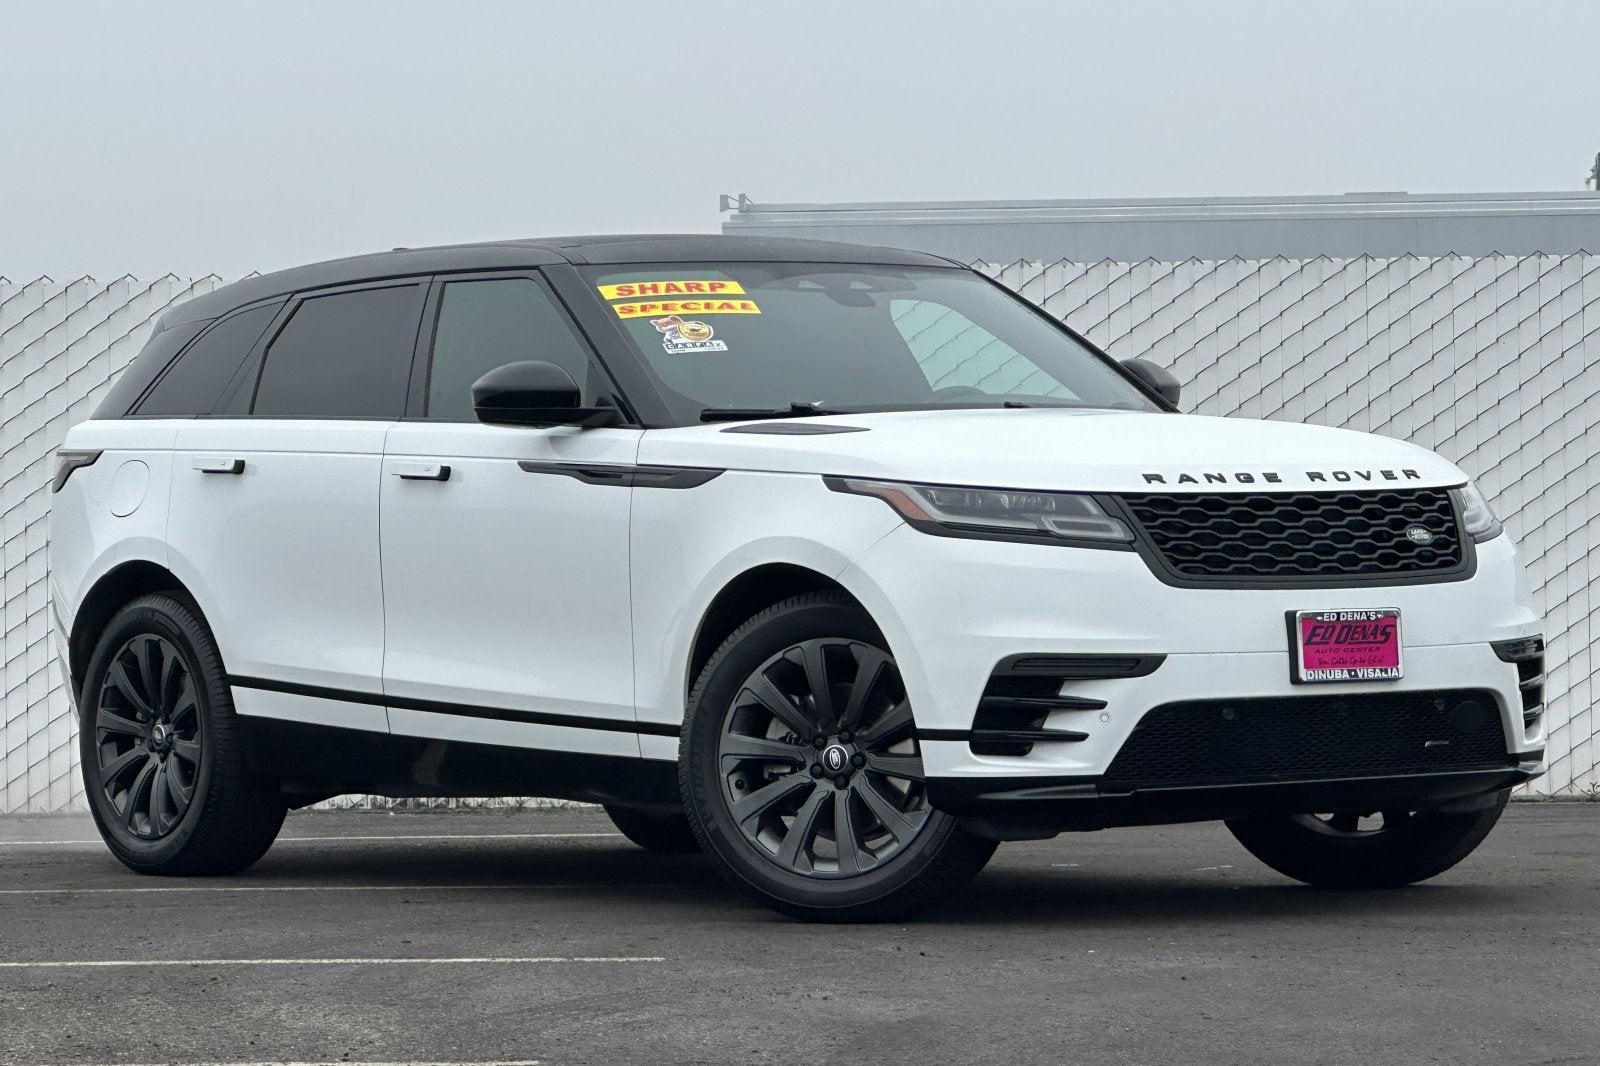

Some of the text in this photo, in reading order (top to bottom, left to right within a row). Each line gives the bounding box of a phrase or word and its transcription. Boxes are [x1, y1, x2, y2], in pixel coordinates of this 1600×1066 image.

[615, 282, 727, 297] SHARP
[618, 302, 756, 315] SPECIAL
[1141, 468, 1421, 484] RANGE ROVER
[1323, 611, 1377, 621] ED DENA'S
[1304, 625, 1336, 645] ED
[1306, 667, 1399, 680] DINUBA VISALIA
